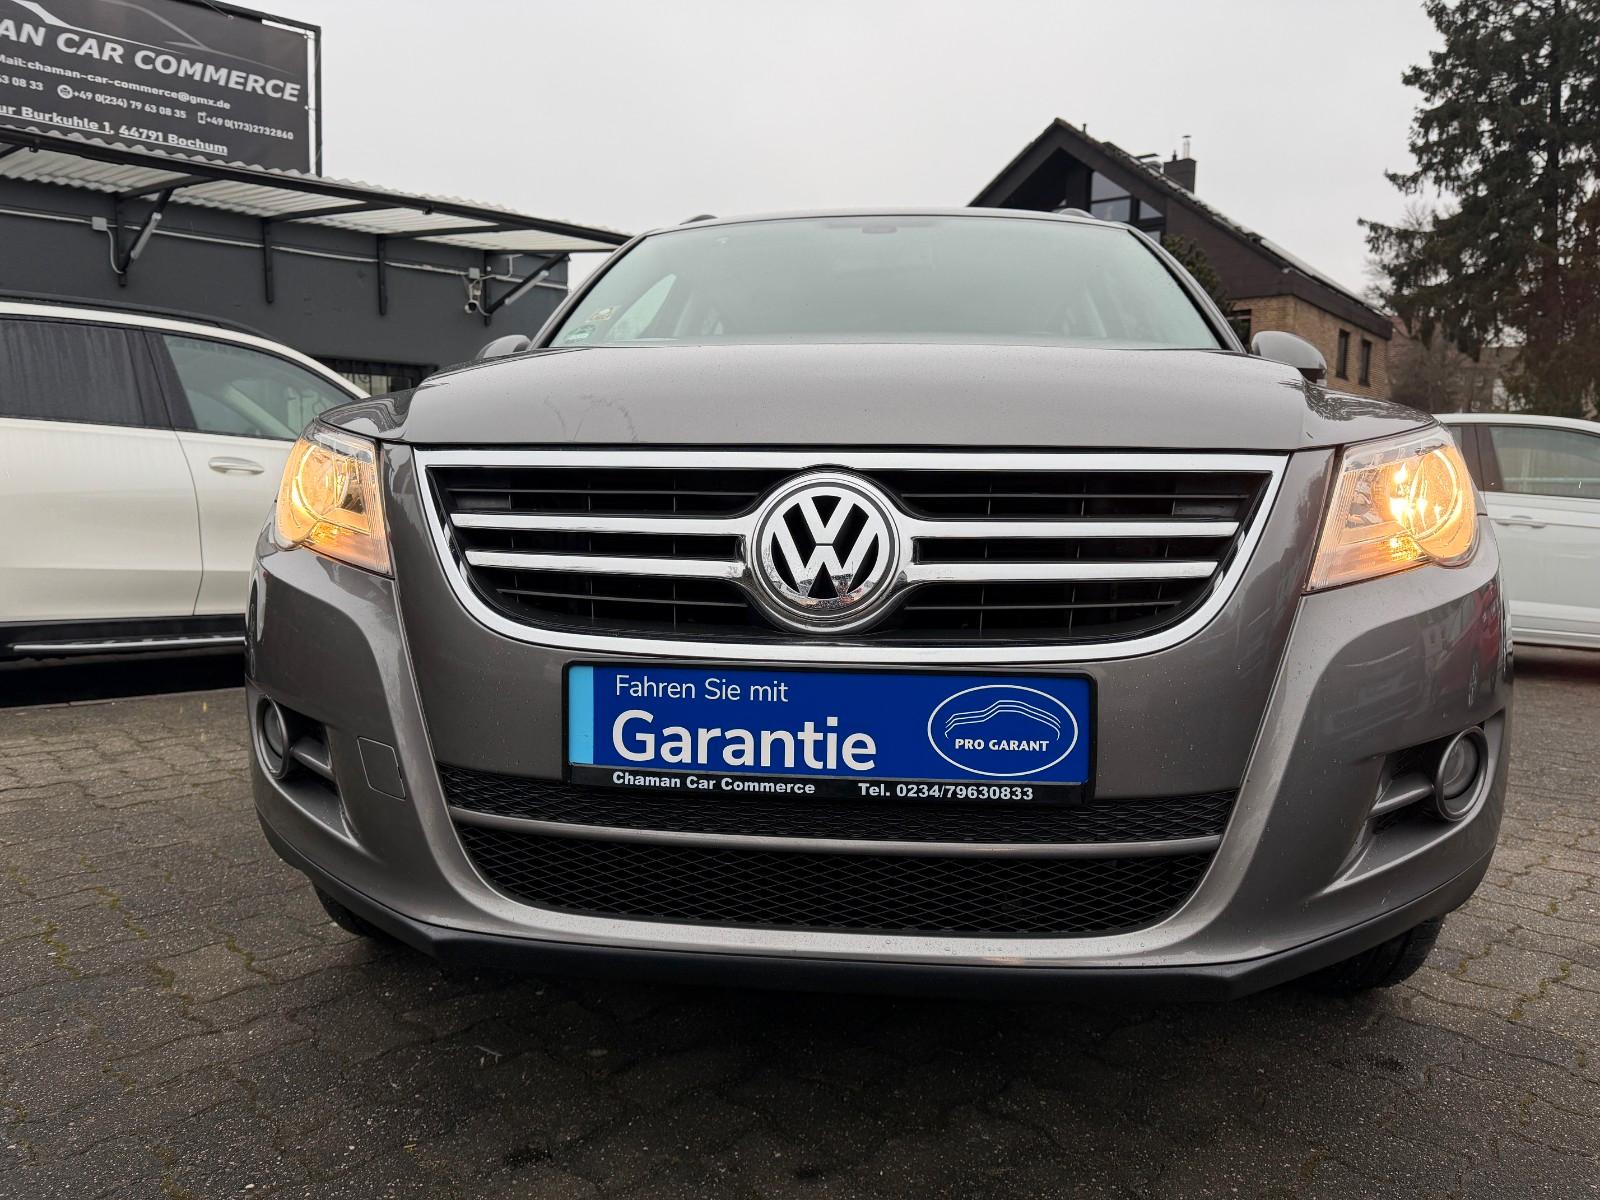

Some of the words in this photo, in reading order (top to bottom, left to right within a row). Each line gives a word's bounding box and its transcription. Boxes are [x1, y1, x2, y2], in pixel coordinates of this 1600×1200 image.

[56, 32, 125, 65] CAR
[134, 49, 301, 102] COMMERCE
[12, 76, 27, 88] 08
[29, 80, 44, 91] 33
[94, 93, 128, 109] 0(234)
[129, 100, 143, 111] 79
[144, 103, 158, 114] 63
[21, 106, 100, 131] Burkuhle
[119, 125, 164, 143] 44791
[167, 133, 228, 156] Bochum
[615, 674, 696, 699] Fahren
[704, 677, 741, 701] Sie
[749, 680, 789, 702] mit
[612, 709, 877, 771] Garantie
[954, 738, 985, 750] PRO
[988, 739, 1050, 752] GARANT
[612, 771, 681, 788] Chaman
[686, 775, 717, 790] Car
[721, 777, 816, 795] Commerce
[858, 782, 891, 797] Tel.
[896, 784, 1034, 801] 0234/79630833
